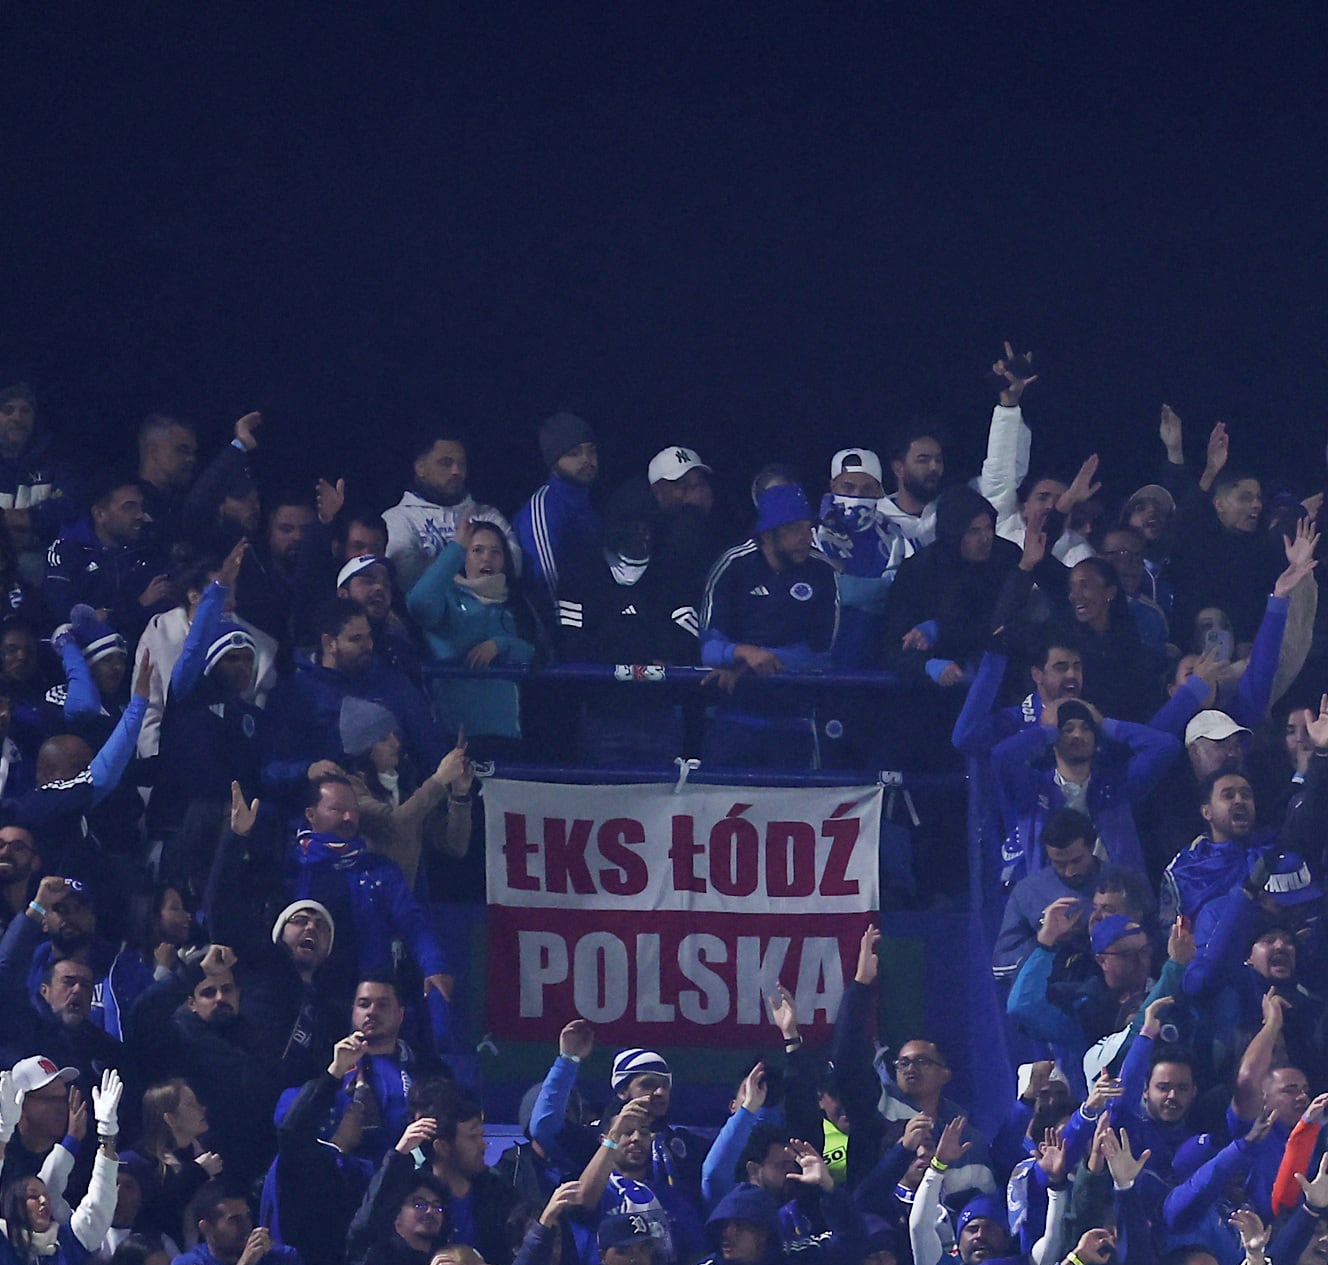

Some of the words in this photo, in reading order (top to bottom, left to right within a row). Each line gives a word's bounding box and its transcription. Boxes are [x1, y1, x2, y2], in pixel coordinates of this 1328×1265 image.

[502, 813, 648, 897] ŁKS
[667, 802, 860, 900] ŁÓDŹ
[517, 929, 847, 1028] POLSKA
